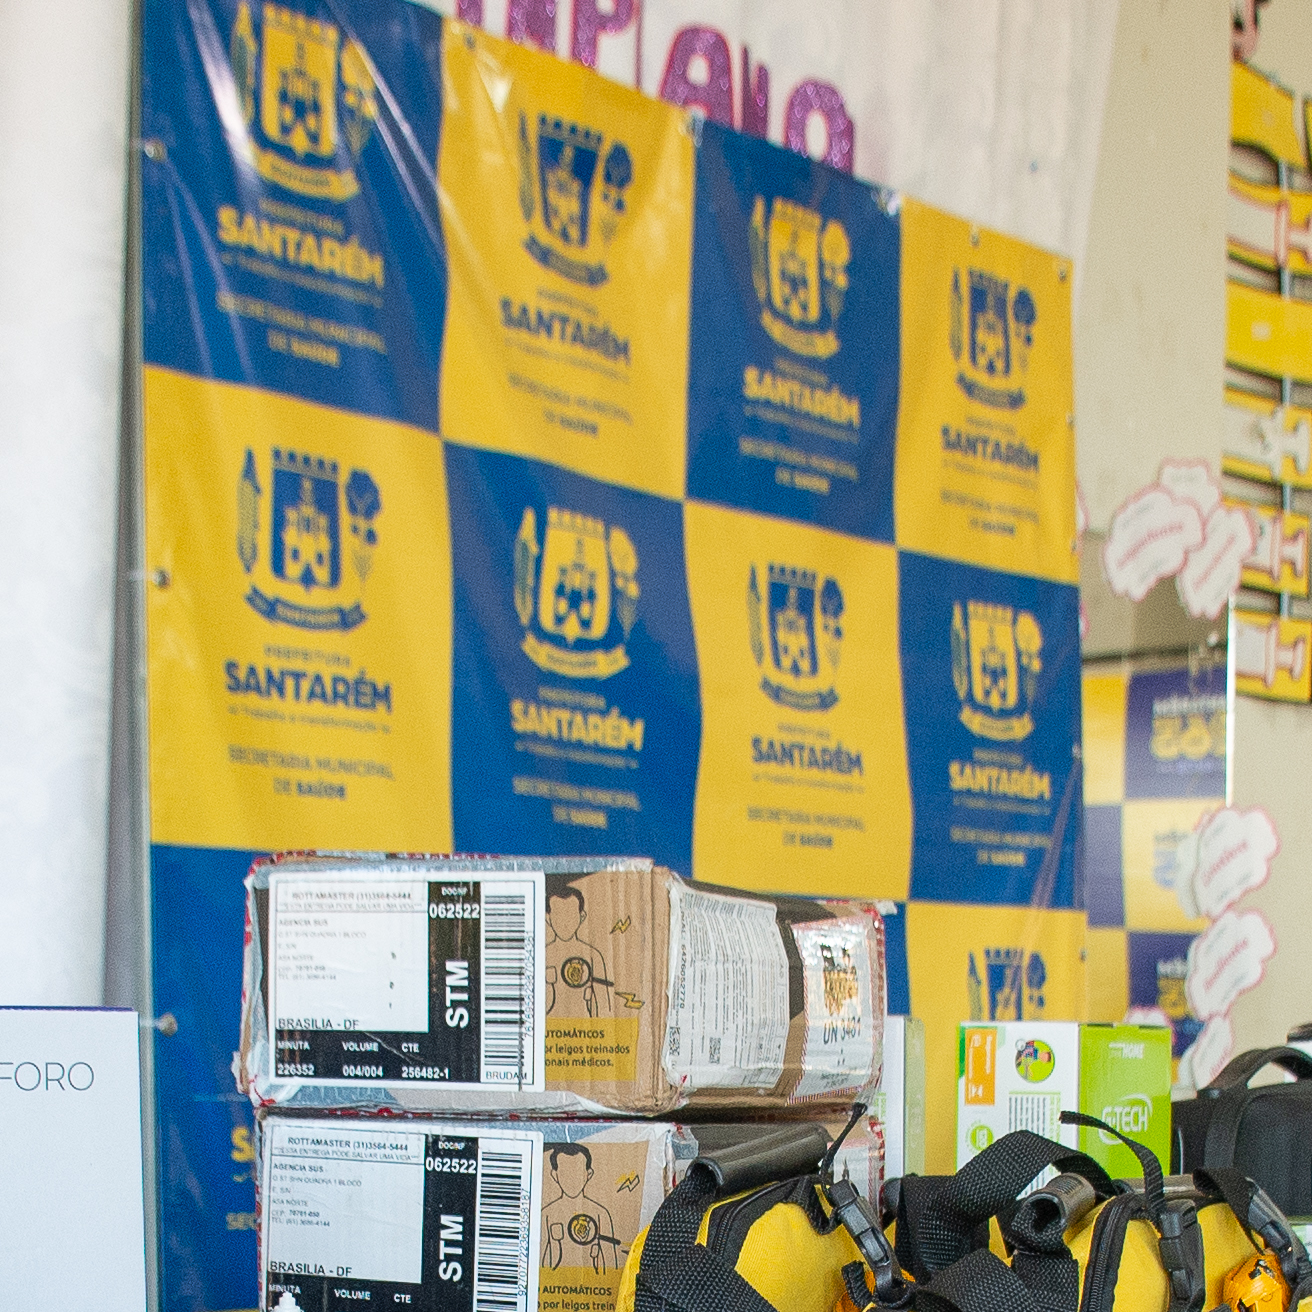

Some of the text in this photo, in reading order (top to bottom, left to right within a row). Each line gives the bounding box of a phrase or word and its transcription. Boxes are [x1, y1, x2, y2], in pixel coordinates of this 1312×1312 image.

[217, 206, 384, 288] SANTARÉM
[500, 298, 631, 366] SANTARÉM
[743, 365, 861, 427] SANTARÉM
[942, 426, 1040, 473] SANTARÉM
[224, 659, 393, 715] SANTARÉM
[511, 700, 645, 752] SANTARÉM
[751, 734, 864, 777] SANTARÉM
[948, 761, 1051, 801] SANTARÉM
[429, 903, 480, 919] 062522
[445, 960, 469, 1028] STM
[344, 1019, 360, 1030] DF
[545, 1027, 605, 1039] UTOMÁTICOS
[822, 1022, 838, 1045] UN
[277, 1041, 420, 1053] MINUTA VOLUME CTE
[586, 1044, 630, 1054] treinados
[342, 1065, 383, 1078] 004/004
[401, 1067, 450, 1079] 256482-1
[485, 1070, 527, 1081] BRUDAM
[288, 1137, 351, 1148] ROTTAMASTER
[273, 1164, 324, 1173] AGENCIA SUS
[425, 1156, 476, 1174] 062522
[439, 1214, 464, 1282] STM
[336, 1266, 353, 1277] DF
[334, 1288, 371, 1301] VOLUME
[394, 1293, 412, 1304] CTE
[542, 1284, 612, 1296] AUTOMÁTICOS
[543, 1299, 615, 1312] por leigos trein
